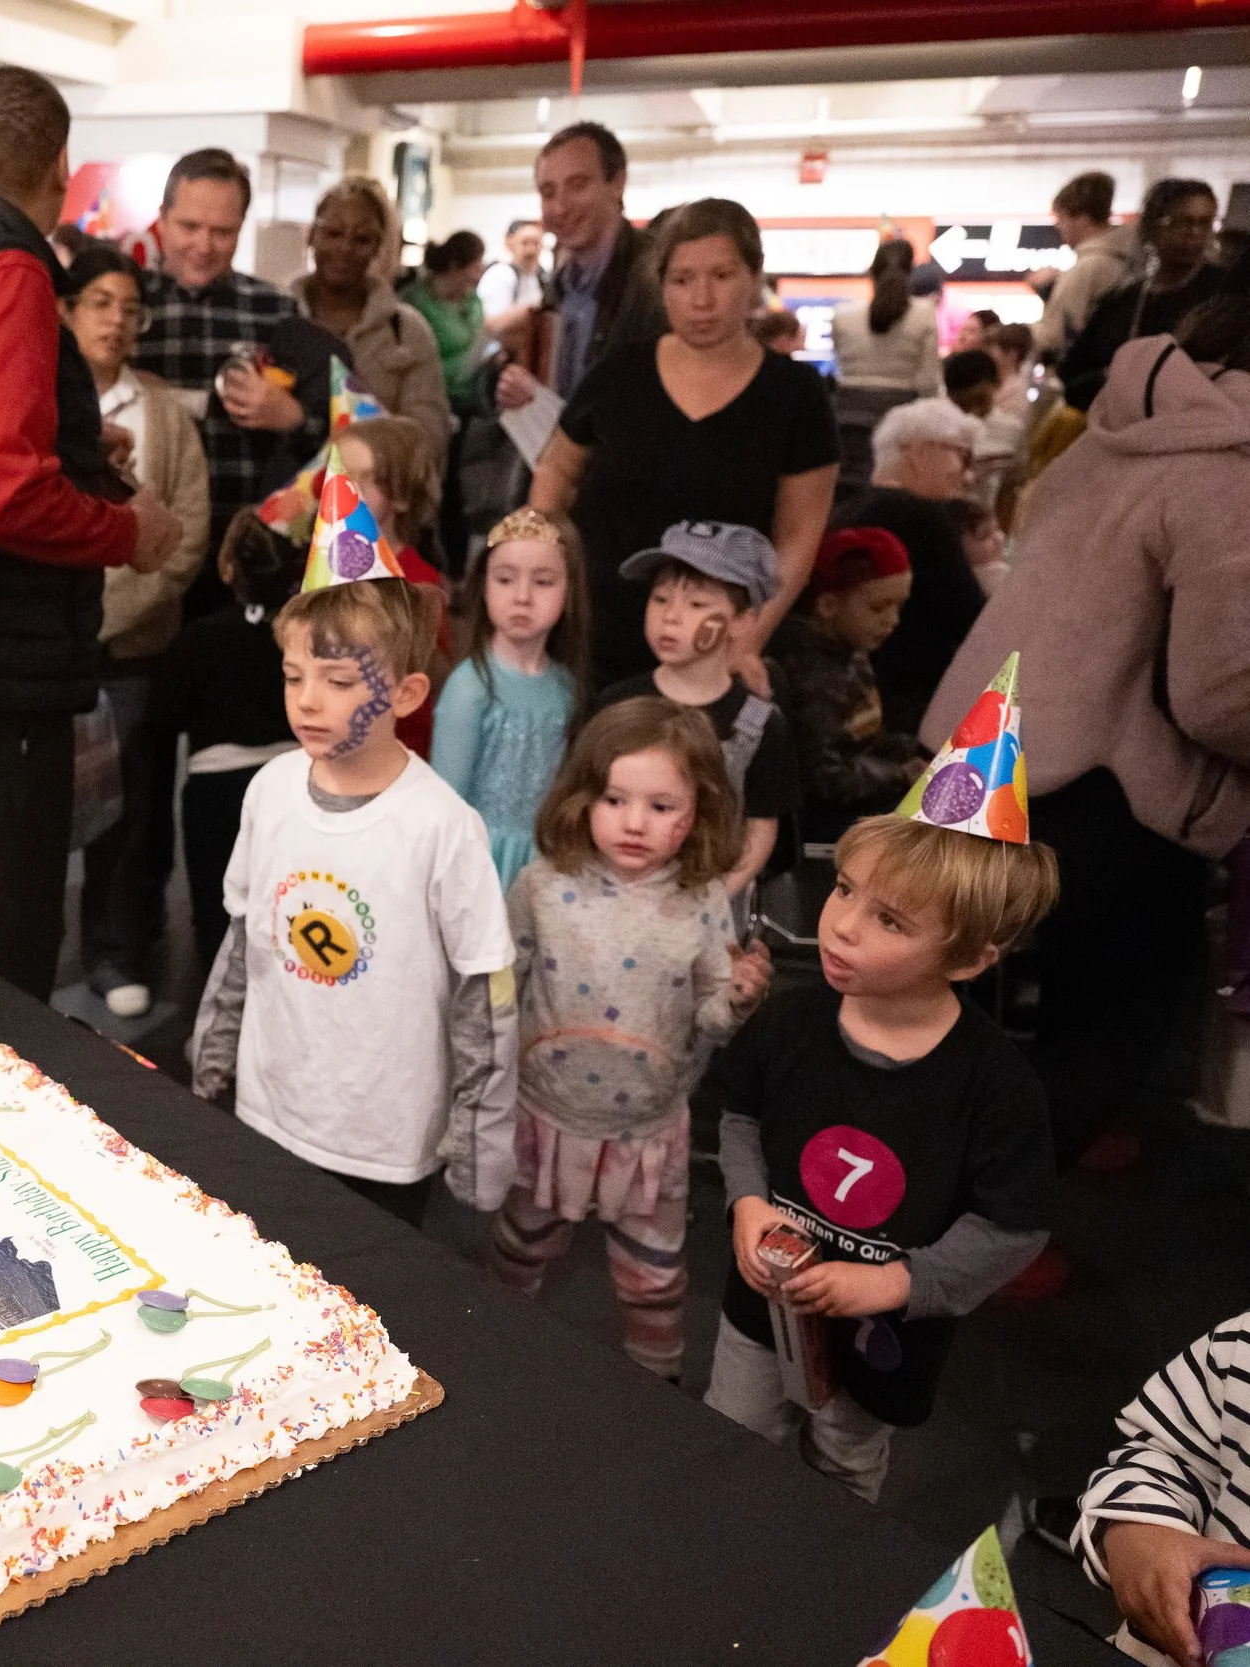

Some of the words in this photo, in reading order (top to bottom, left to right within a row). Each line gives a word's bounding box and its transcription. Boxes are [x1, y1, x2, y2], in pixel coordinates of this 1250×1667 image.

[300, 919, 348, 967] R
[834, 1147, 874, 1203] 7
[10, 1171, 82, 1239] Birthday
[72, 1231, 132, 1282] Happy
[838, 1234, 856, 1252] to
